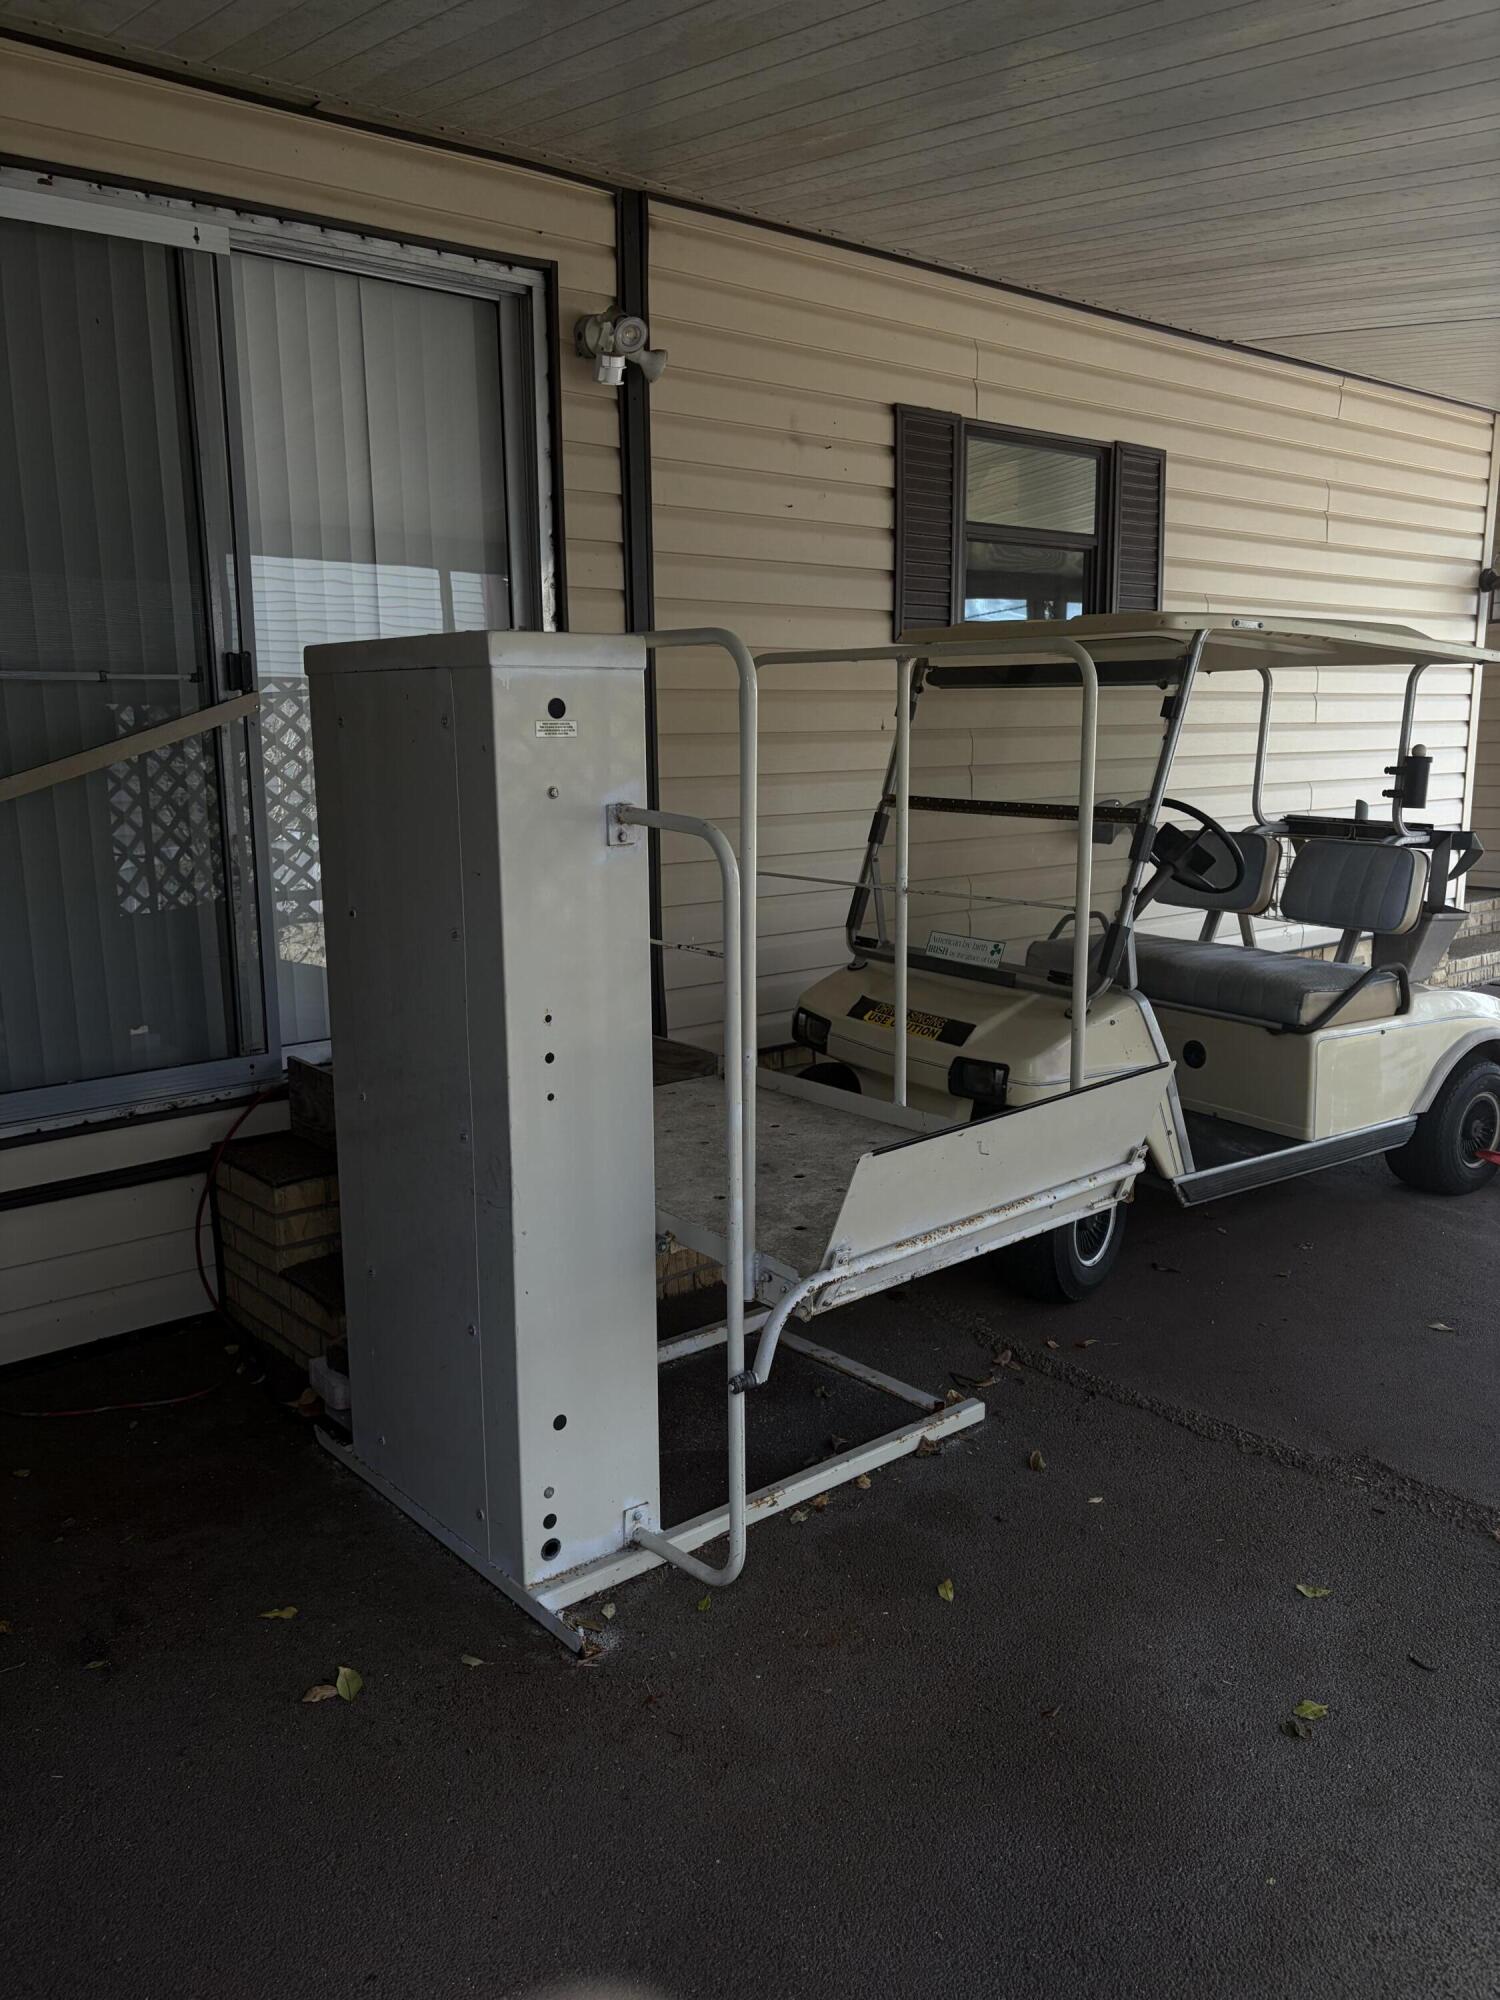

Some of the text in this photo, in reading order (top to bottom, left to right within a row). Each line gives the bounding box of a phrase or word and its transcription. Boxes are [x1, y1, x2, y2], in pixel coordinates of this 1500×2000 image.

[932, 935, 961, 947] American
[928, 944, 949, 956] IRISH
[868, 1012, 940, 1038] USE CUTION
